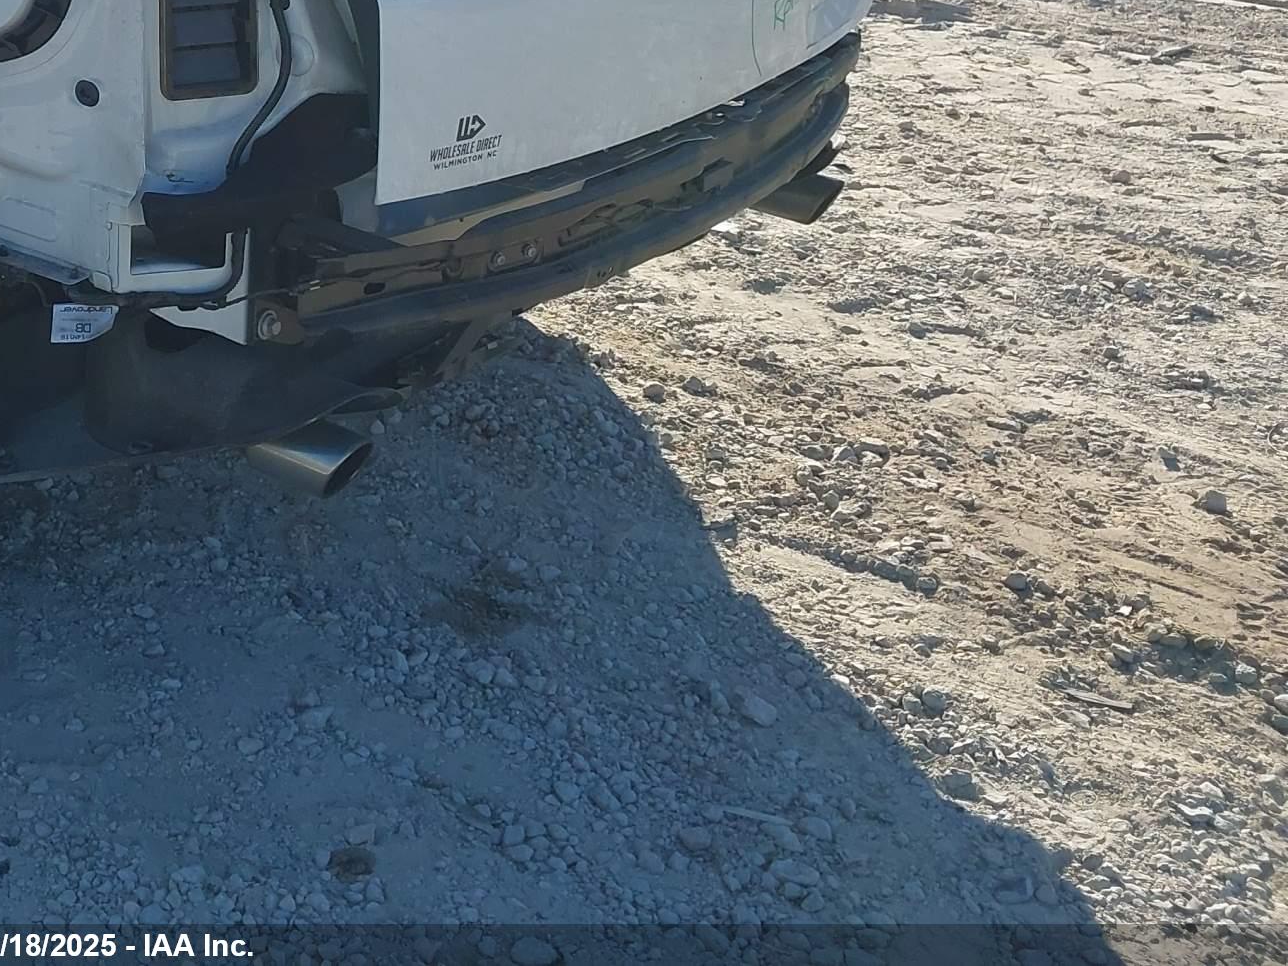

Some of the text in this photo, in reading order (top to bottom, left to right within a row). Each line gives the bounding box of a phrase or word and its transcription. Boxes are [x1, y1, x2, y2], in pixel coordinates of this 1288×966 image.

[429, 134, 502, 163] WHOLESALE DIRECT
[433, 150, 498, 171] WILMINGTON NC
